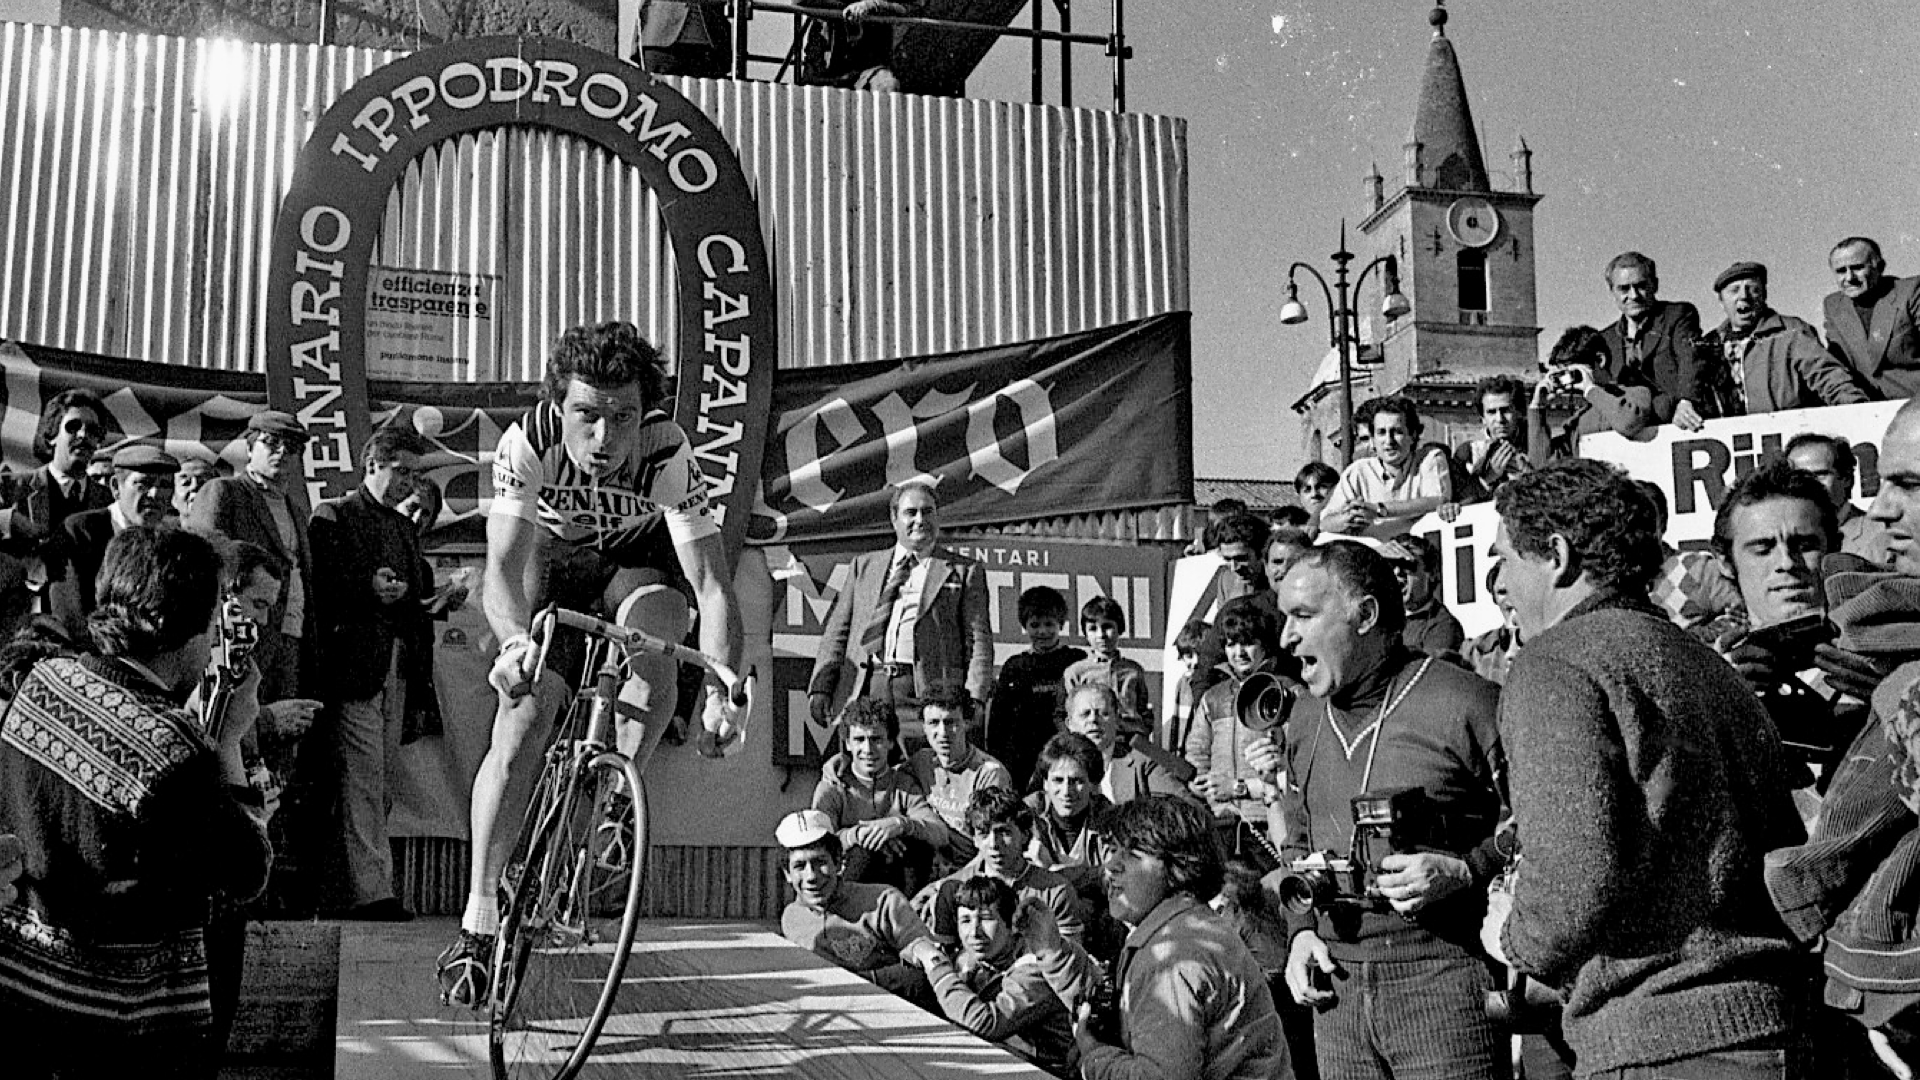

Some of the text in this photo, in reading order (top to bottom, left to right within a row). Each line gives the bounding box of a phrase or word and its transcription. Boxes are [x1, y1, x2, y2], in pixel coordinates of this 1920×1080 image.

[290, 206, 353, 512] TENARIO
[331, 57, 718, 193] IPPODROMO
[694, 235, 750, 526] CAPANN
[371, 292, 488, 314] trasparene
[946, 546, 1049, 567] ENTARI
